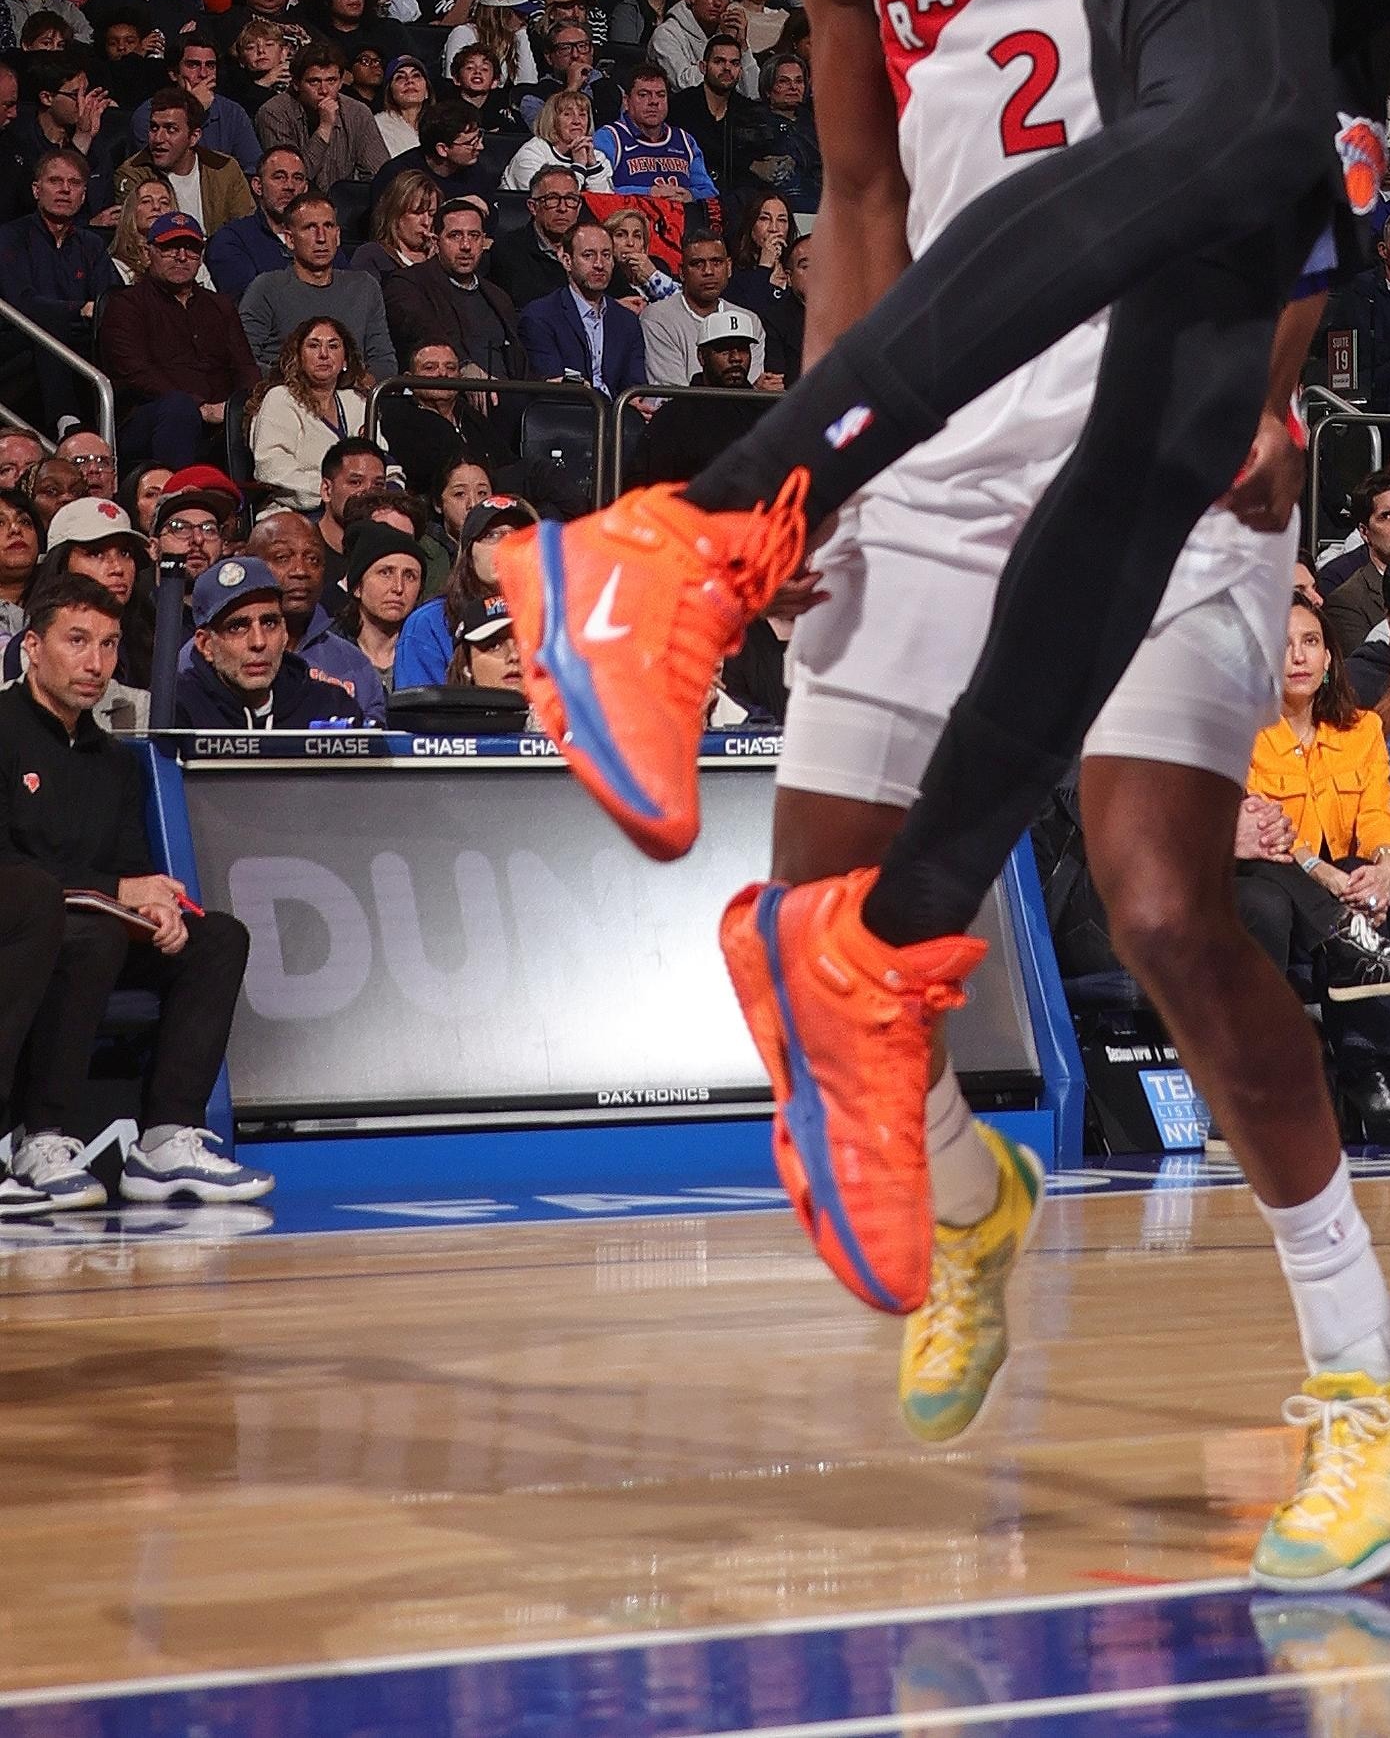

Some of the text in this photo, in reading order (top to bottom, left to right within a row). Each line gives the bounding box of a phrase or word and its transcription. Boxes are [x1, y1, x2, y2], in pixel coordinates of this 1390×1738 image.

[987, 30, 1068, 157] 2
[626, 155, 690, 179] NEW YORK
[730, 316, 739, 331] B
[1332, 336, 1349, 349] SUITE
[1334, 349, 1349, 371] 19
[195, 737, 261, 755] CHASE
[304, 737, 370, 755] CHASE
[412, 738, 477, 756] CHASE
[519, 738, 562, 755] CHA
[597, 1087, 710, 1105] DAKTRONICS
